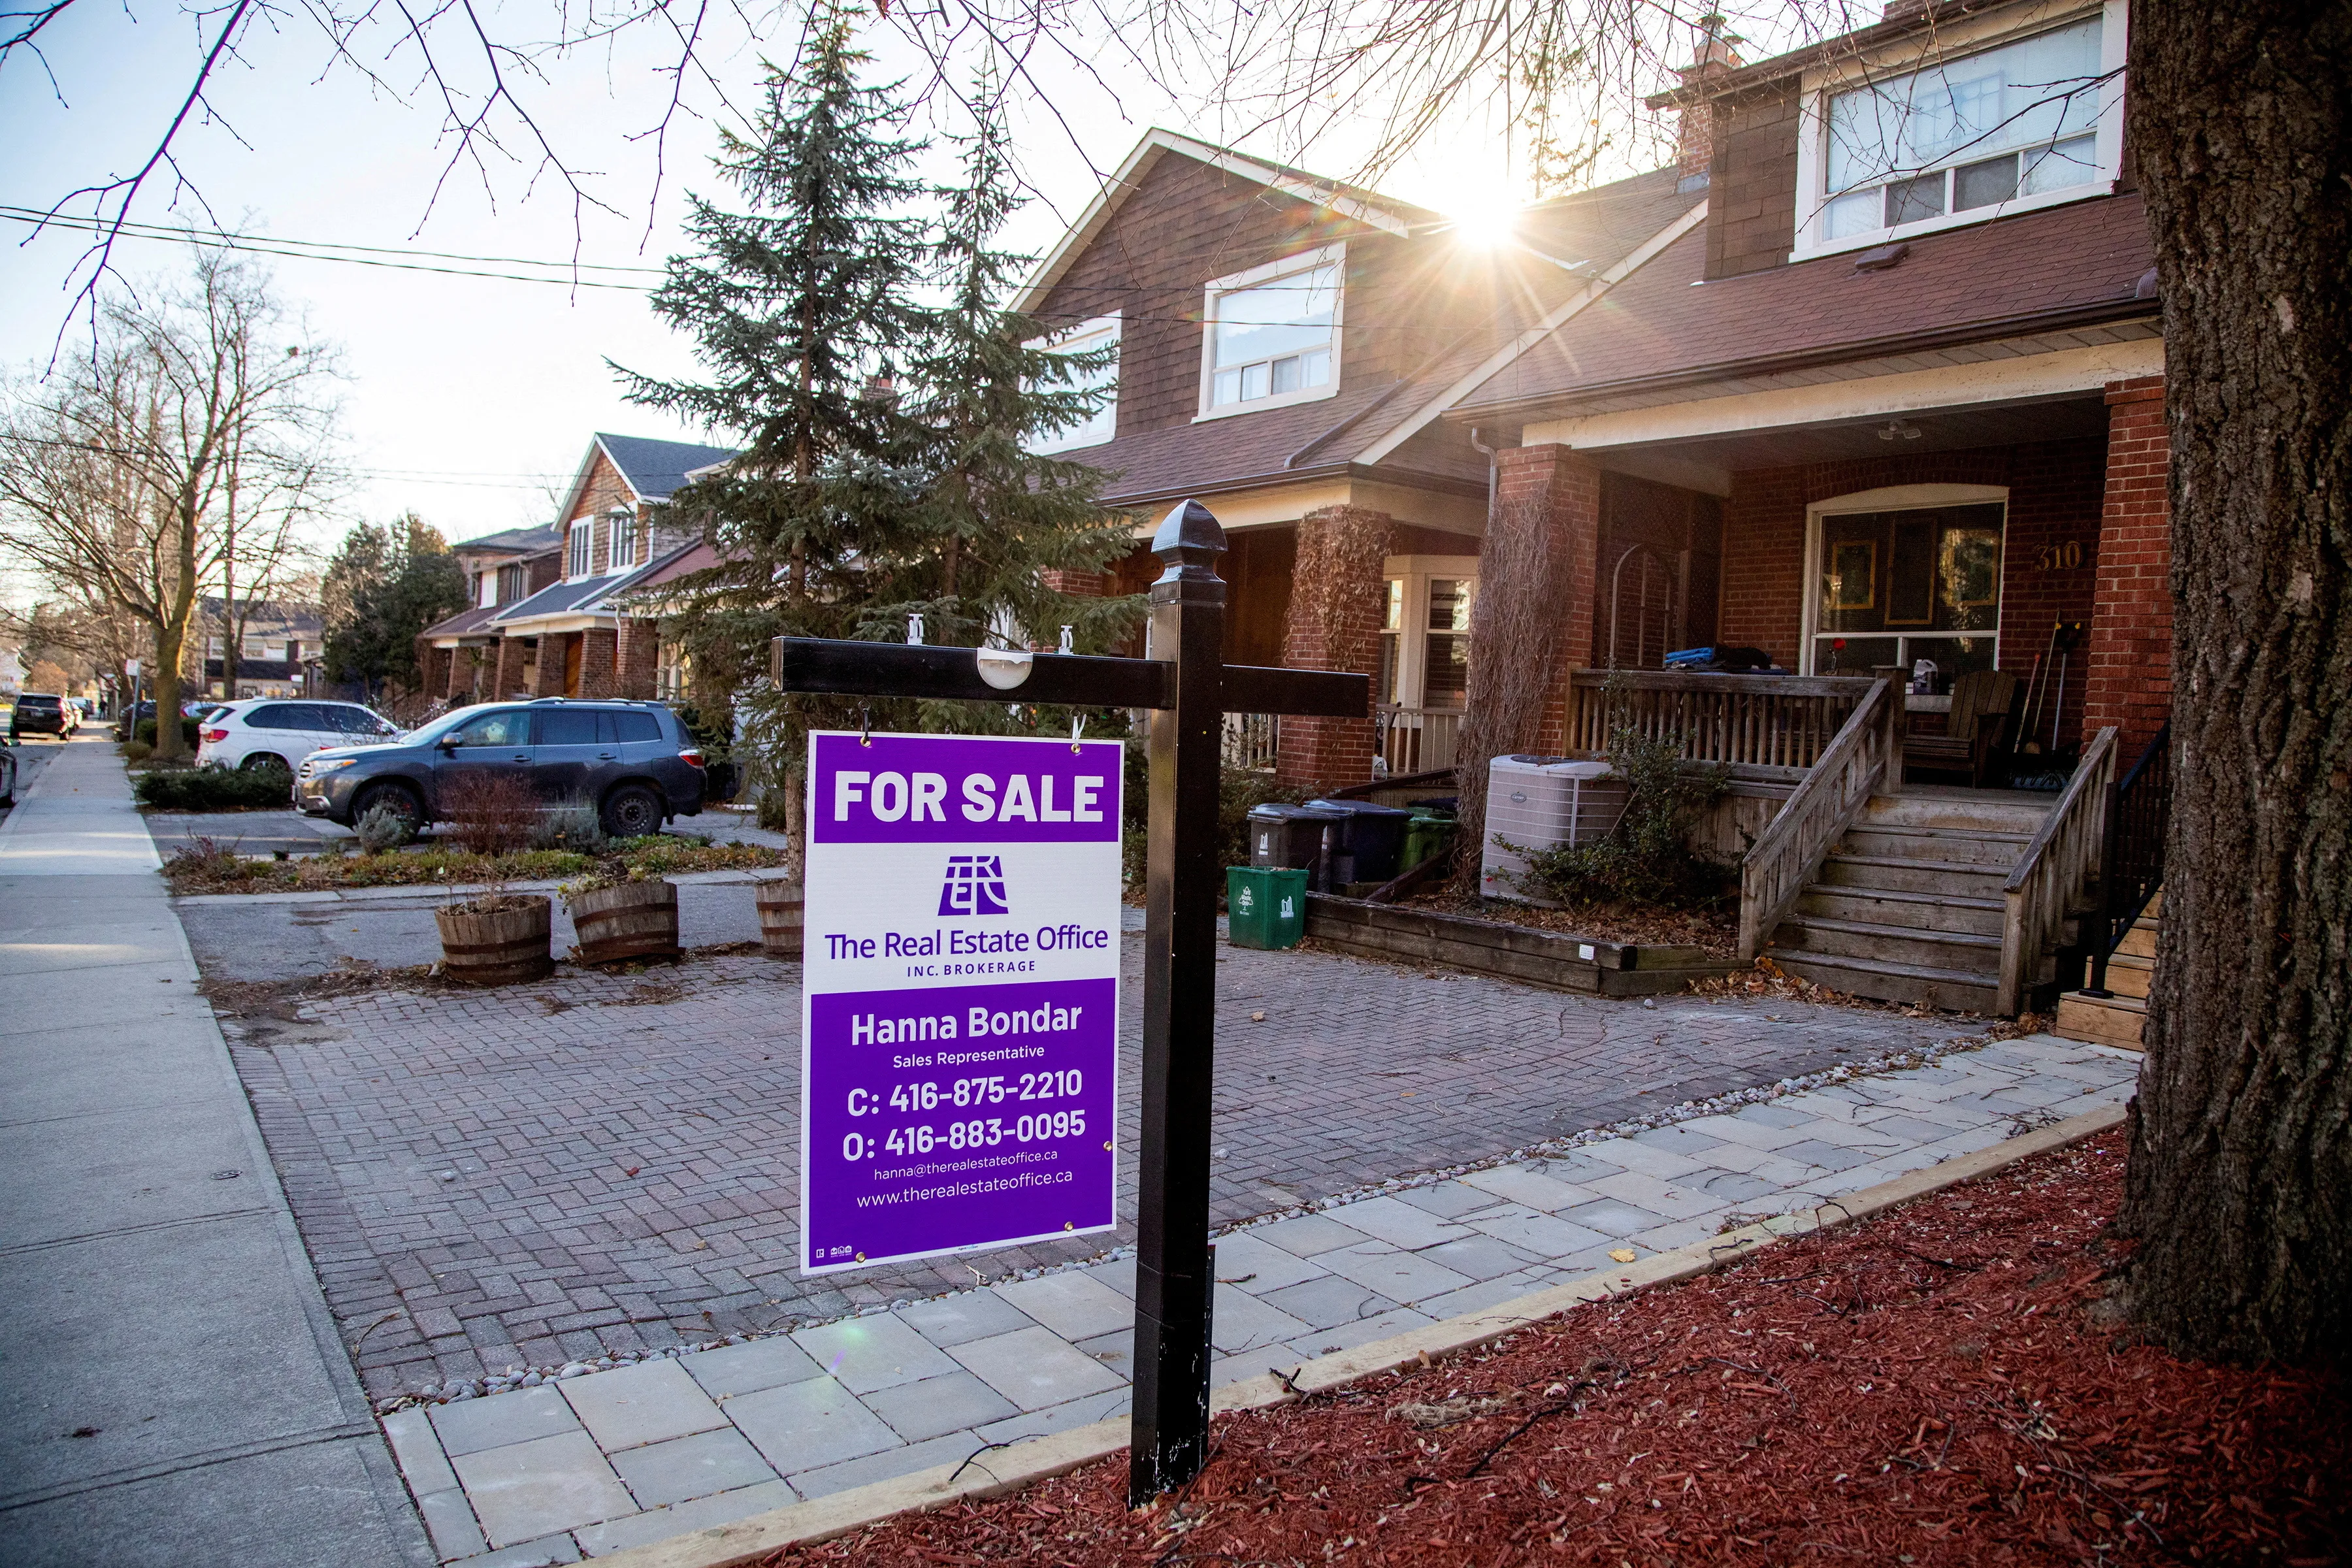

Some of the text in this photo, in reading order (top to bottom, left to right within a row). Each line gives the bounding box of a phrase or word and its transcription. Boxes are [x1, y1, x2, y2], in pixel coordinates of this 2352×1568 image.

[2034, 540, 2083, 572] 310
[834, 770, 1104, 823] FOR SALE
[825, 924, 1109, 960] The Real Estate Office
[907, 960, 1036, 977] INC. BROKERAGE
[852, 1002, 1083, 1046] Hanna Bondar
[893, 1045, 1045, 1068] Sales Representative
[847, 1069, 1083, 1117] C: 416-875-2210
[843, 1109, 1086, 1162] O: 416-883-0095
[874, 1149, 1058, 1181] hanna@therealestateoffice.ca
[857, 1171, 1073, 1208] www.therealestateoffice.ca
